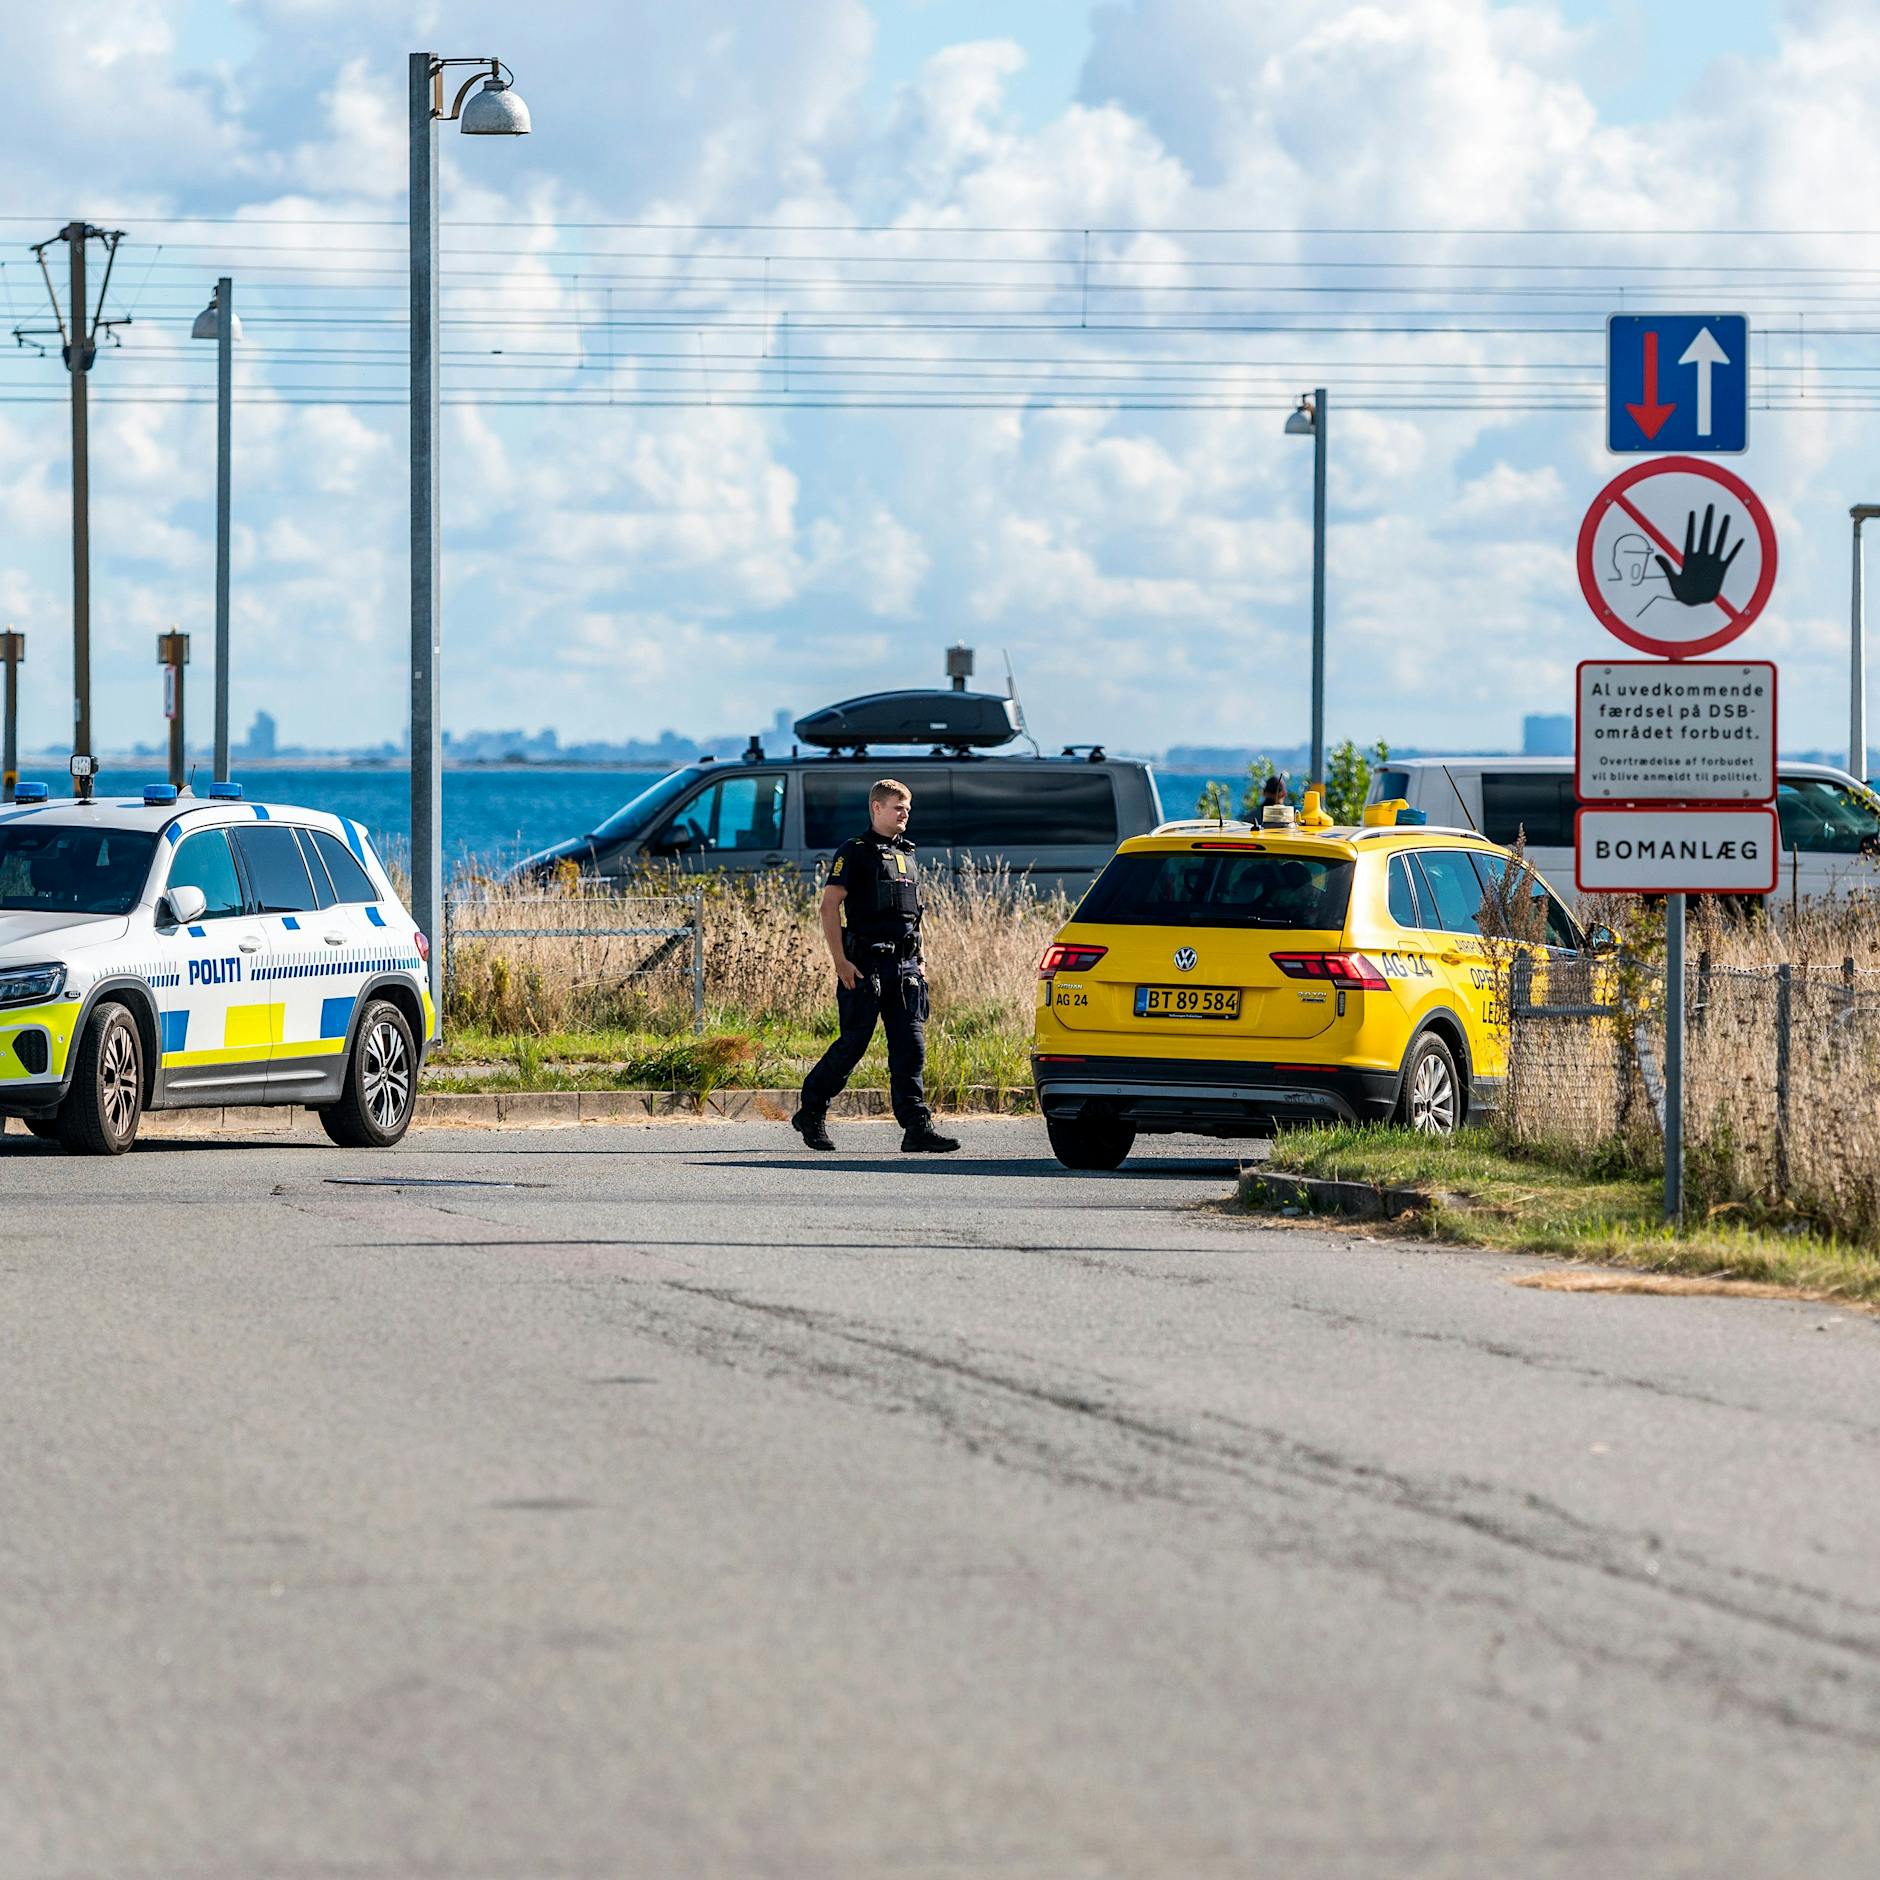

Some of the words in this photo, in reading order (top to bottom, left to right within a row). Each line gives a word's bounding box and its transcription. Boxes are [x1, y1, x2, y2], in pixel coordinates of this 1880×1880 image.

[1591, 683, 1610, 696] Al
[1617, 682, 1764, 696] uvedkommende
[1599, 704, 1672, 718] færdsel
[1680, 704, 1700, 720] på
[1709, 704, 1755, 718] DSB-
[1594, 725, 1673, 739] området
[1681, 725, 1760, 739] forbudt.
[1599, 756, 1681, 766] Overtrædelse
[1685, 756, 1697, 766] af
[1701, 756, 1754, 766] forbudet
[1592, 772, 1606, 781] vil
[1610, 772, 1639, 781] blive
[1643, 772, 1691, 781] anmeldt
[1695, 772, 1709, 781] til
[1712, 772, 1762, 782] politiet.
[1596, 840, 1758, 860] BOMANLÆG
[188, 957, 241, 985] POLITI
[1381, 952, 1408, 978] AG
[1408, 953, 1433, 978] 24
[1056, 993, 1070, 1006] AG
[1074, 994, 1088, 1006] 24
[1148, 991, 1173, 1008] BT
[1176, 991, 1198, 1010] 89
[1203, 993, 1237, 1011] 584
